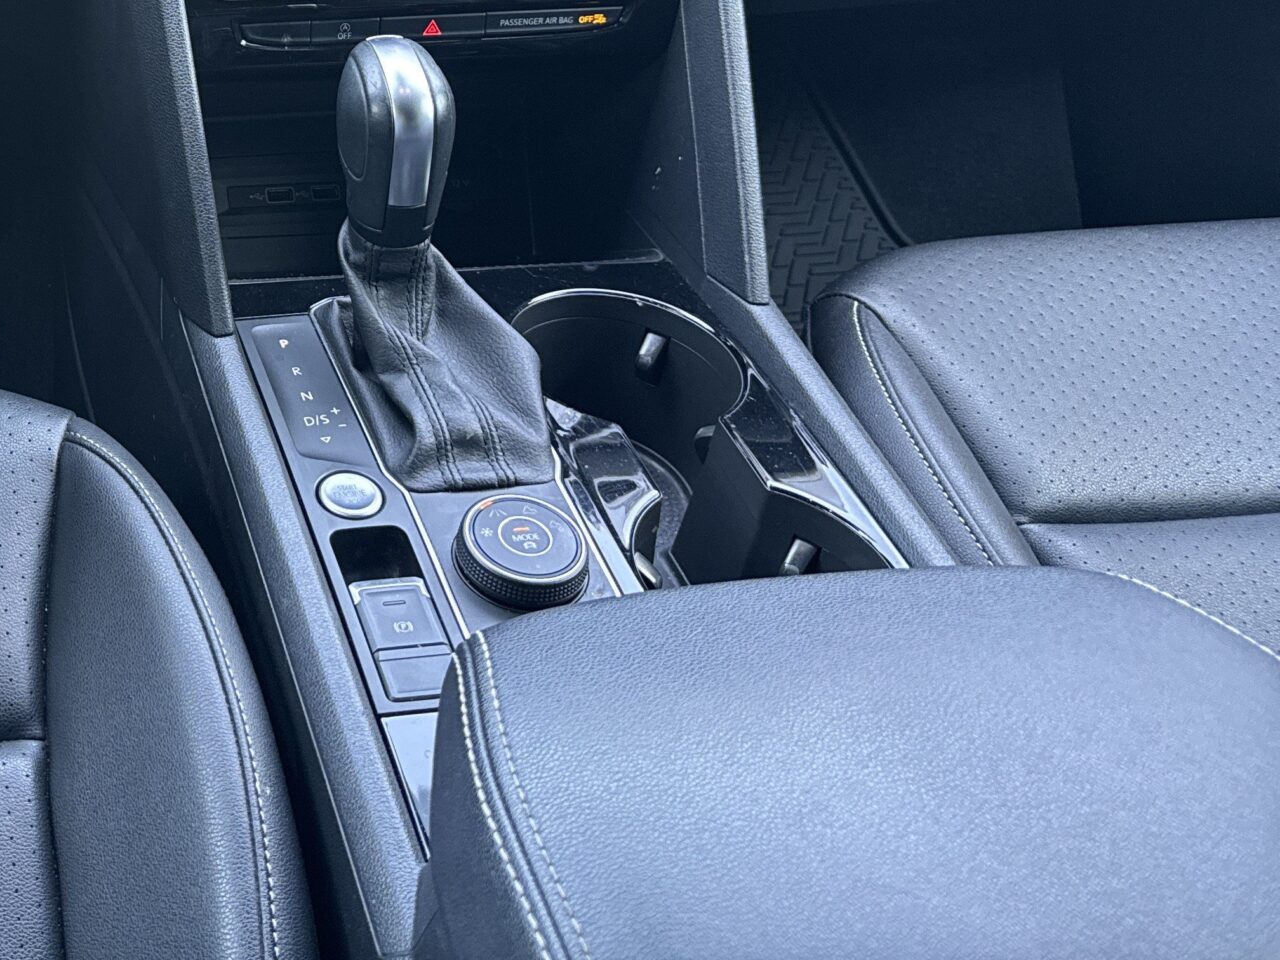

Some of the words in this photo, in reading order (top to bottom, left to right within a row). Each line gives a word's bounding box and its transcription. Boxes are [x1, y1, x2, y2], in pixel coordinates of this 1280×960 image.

[500, 18, 544, 27] PASSENGER
[544, 17, 557, 25] AIR
[558, 16, 574, 24] BAG
[578, 15, 594, 24] OFF
[337, 32, 352, 40] OFF
[279, 338, 289, 349] P
[291, 366, 302, 376] R
[300, 391, 314, 401] N
[303, 413, 330, 427] D/S
[512, 533, 540, 543] MODE
